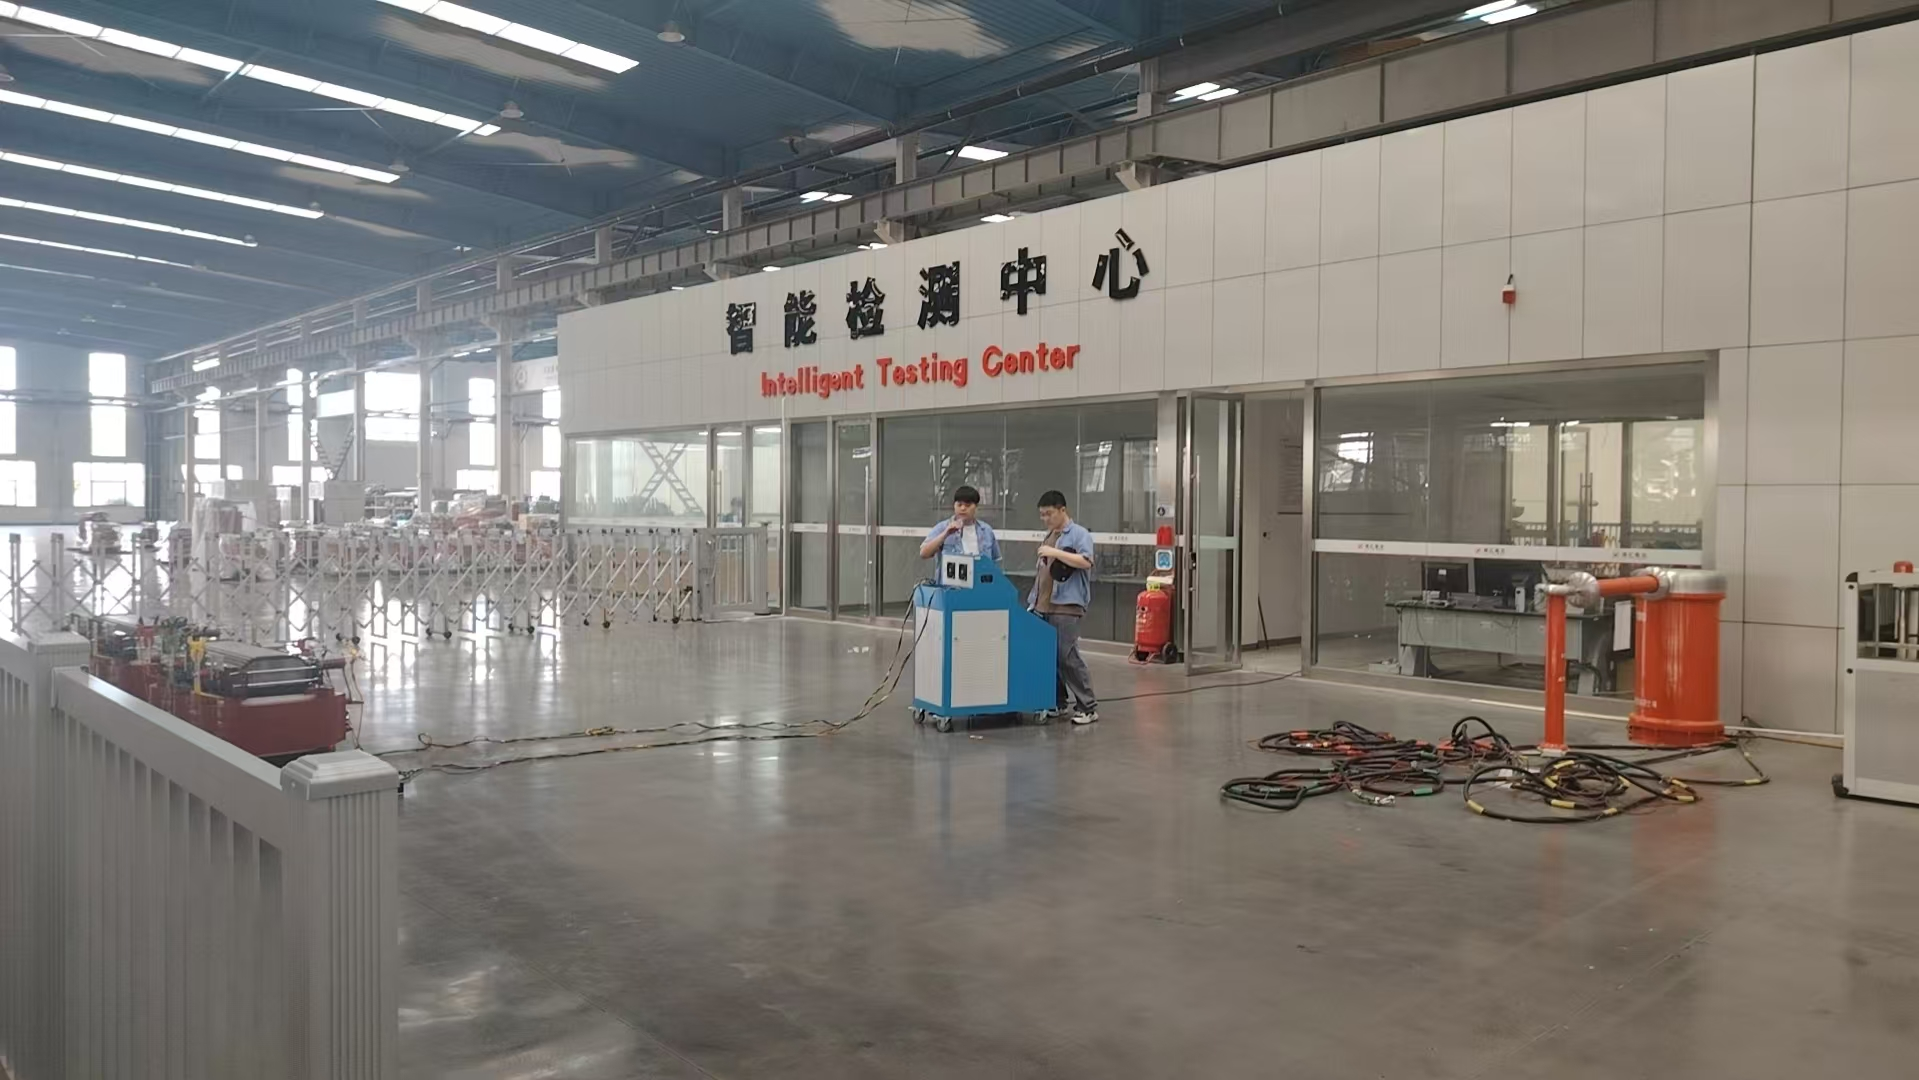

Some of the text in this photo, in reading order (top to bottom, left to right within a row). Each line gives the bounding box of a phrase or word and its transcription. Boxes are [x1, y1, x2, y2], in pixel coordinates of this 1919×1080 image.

[726, 228, 1150, 354] 智能检测中心
[761, 342, 1081, 399] Intelligent Testing Center
